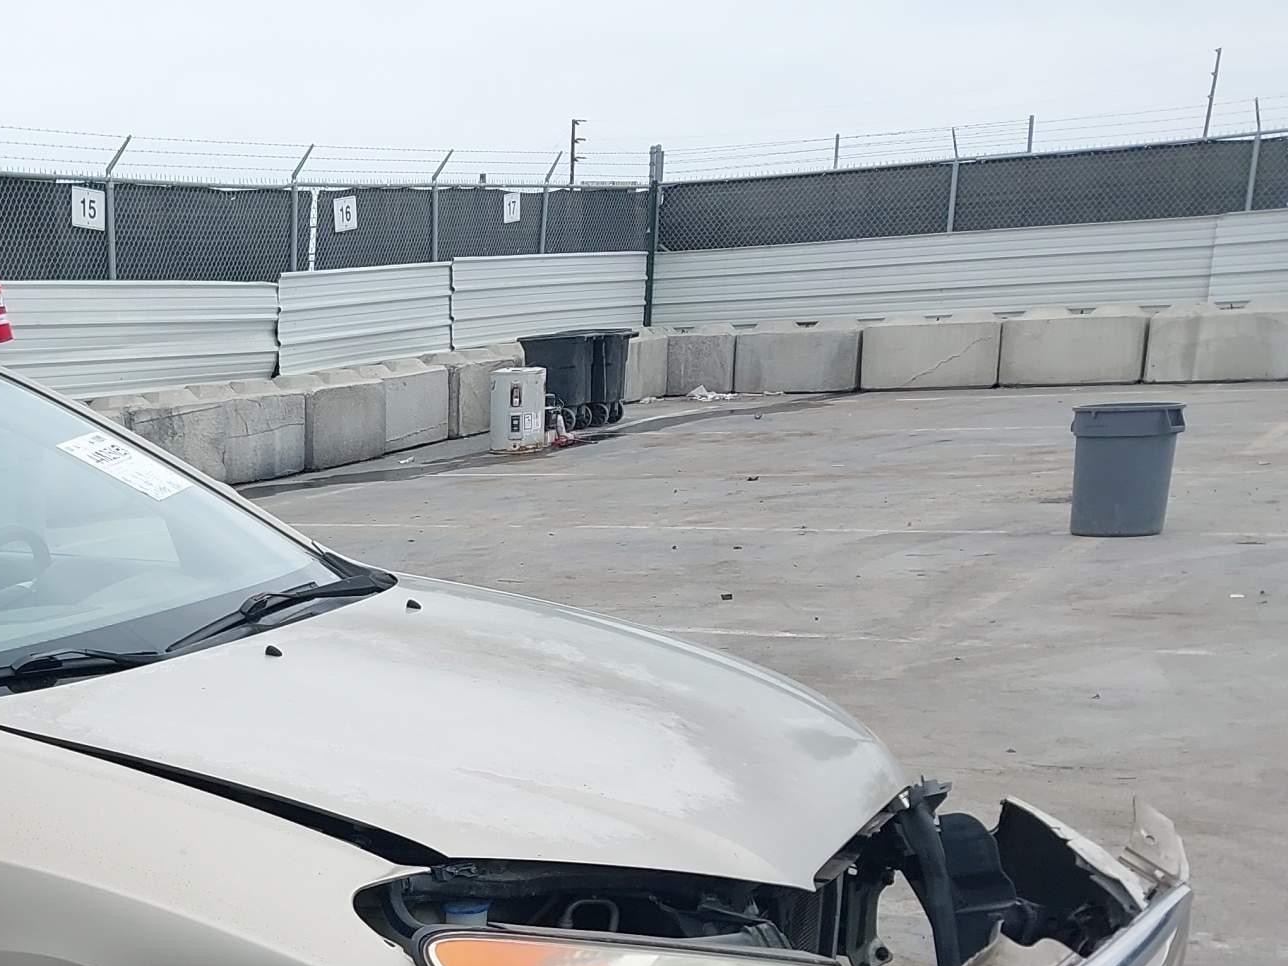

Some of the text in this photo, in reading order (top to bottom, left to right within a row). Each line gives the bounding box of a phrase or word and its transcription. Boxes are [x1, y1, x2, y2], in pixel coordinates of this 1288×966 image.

[80, 198, 97, 220] 15
[339, 204, 352, 223] 16
[507, 200, 517, 216] 17
